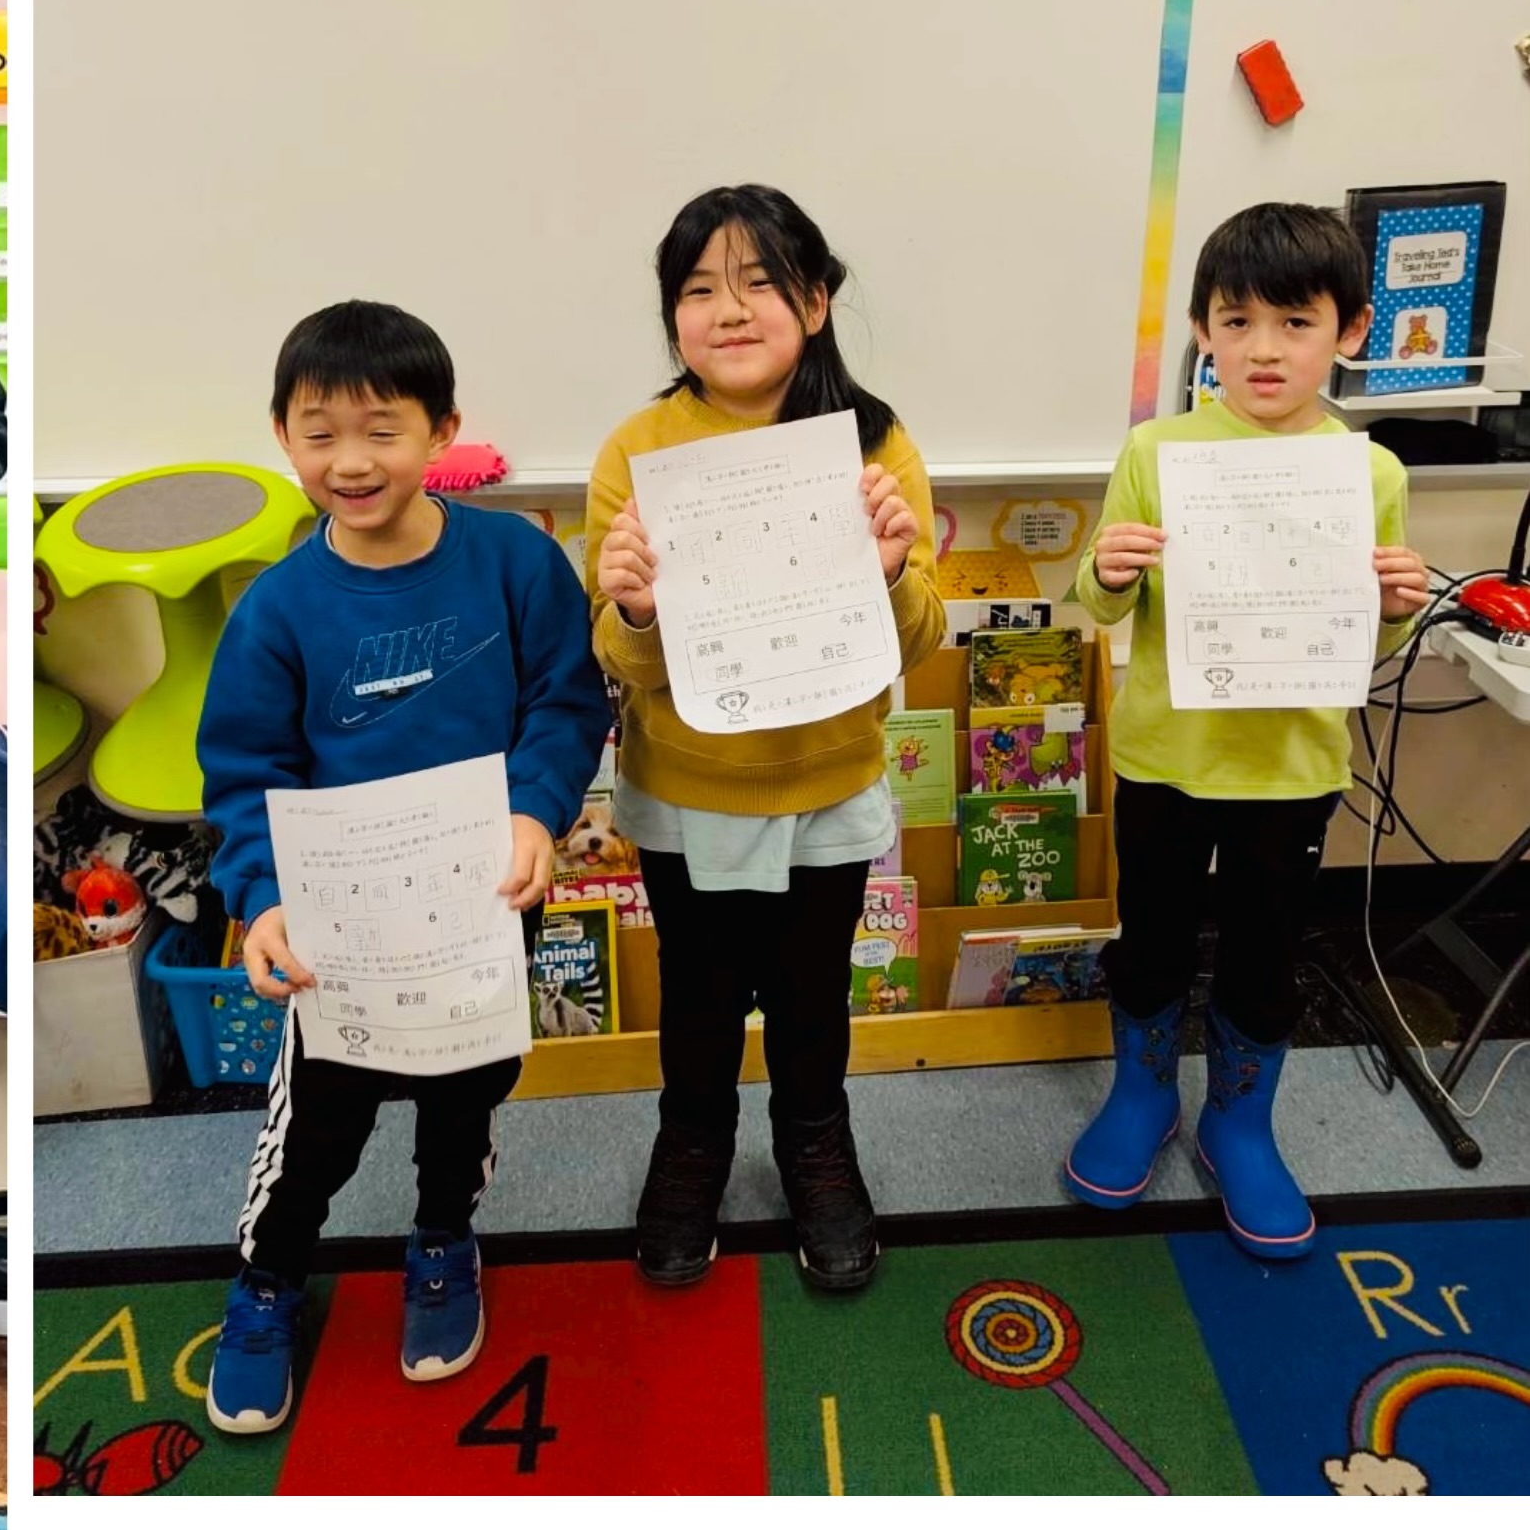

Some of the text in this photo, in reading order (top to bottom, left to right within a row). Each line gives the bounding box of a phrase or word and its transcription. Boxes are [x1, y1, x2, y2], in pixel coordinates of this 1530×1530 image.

[1423, 261, 1451, 271] Home
[809, 512, 819, 523] 4
[762, 521, 771, 533] 3
[1181, 523, 1189, 535] 1
[1222, 524, 1231, 535] 2
[1267, 522, 1275, 534] 3
[1313, 520, 1322, 531] 4
[715, 530, 723, 542] 2
[667, 540, 676, 552] 1
[789, 556, 798, 567] 6
[1207, 560, 1216, 571] 5
[1289, 557, 1298, 568] 6
[702, 574, 711, 586] 5
[839, 611, 868, 627] 今年
[1328, 616, 1357, 631] 今年
[1259, 625, 1288, 641] 歡迎
[695, 639, 725, 659] 高興
[769, 633, 799, 652] 歡迎
[1206, 641, 1234, 657] 同學
[1306, 642, 1335, 658] 自己
[352, 615, 458, 686] NIKE
[820, 642, 850, 661] 自己
[714, 661, 744, 680] 同學
[970, 823, 1019, 845] JACK
[991, 838, 1044, 858] AT THE
[1016, 850, 1062, 869] ZOO
[452, 863, 462, 874] 4
[301, 882, 309, 894] 1
[351, 883, 360, 895] 2
[403, 876, 413, 888] 3
[428, 912, 438, 923] 6
[865, 911, 909, 931] DOG
[333, 922, 343, 933] 5
[533, 940, 596, 964] Animal
[540, 960, 587, 982] Tails
[396, 991, 427, 1007] 歡迎
[449, 1000, 479, 1021] 自己
[1335, 1250, 1473, 1339] Rr
[456, 1354, 559, 1475] 4
